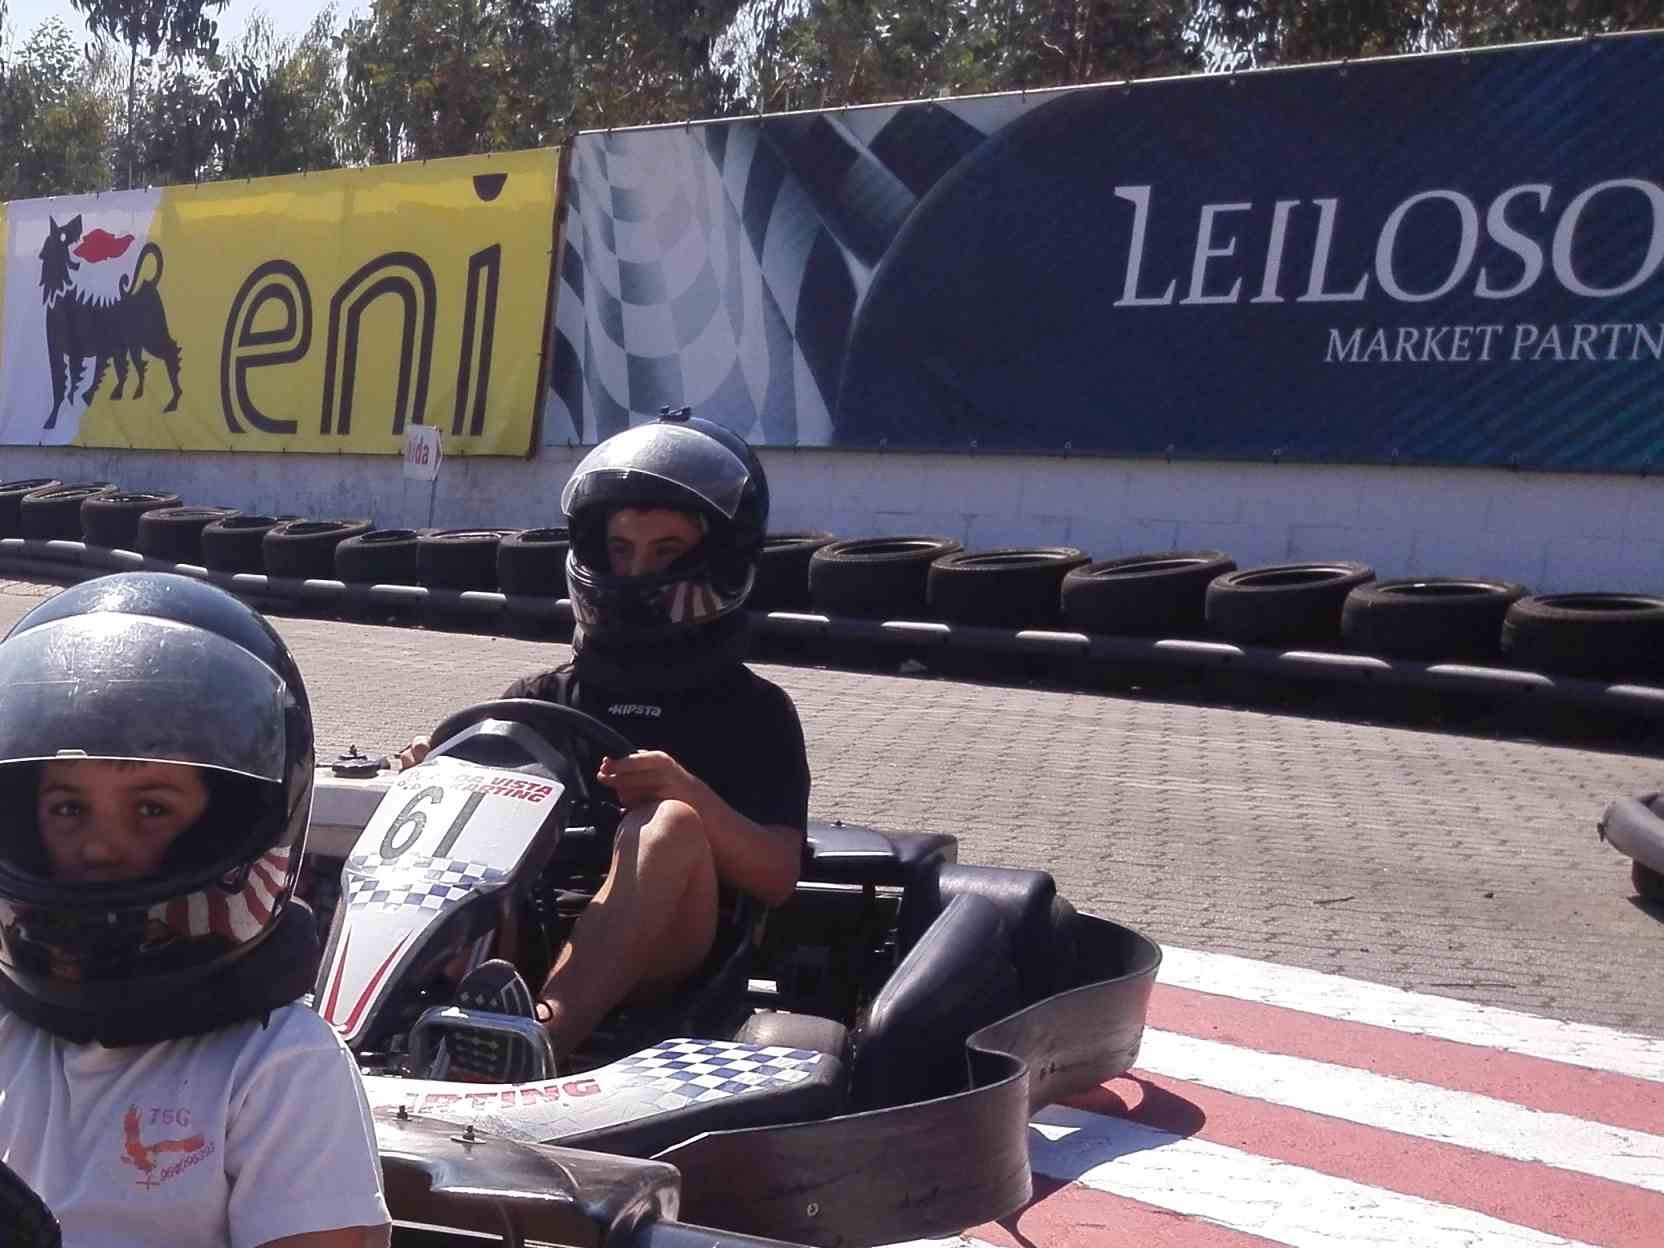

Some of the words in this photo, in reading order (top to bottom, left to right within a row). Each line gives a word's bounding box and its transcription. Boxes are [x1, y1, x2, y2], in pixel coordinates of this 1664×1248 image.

[1113, 178, 1664, 307] LEILOSO
[219, 173, 507, 436] eni
[1324, 325, 1502, 363] MARKET
[1510, 323, 1664, 361] PARTN
[379, 785, 487, 860] 61
[491, 776, 554, 796] VISTA
